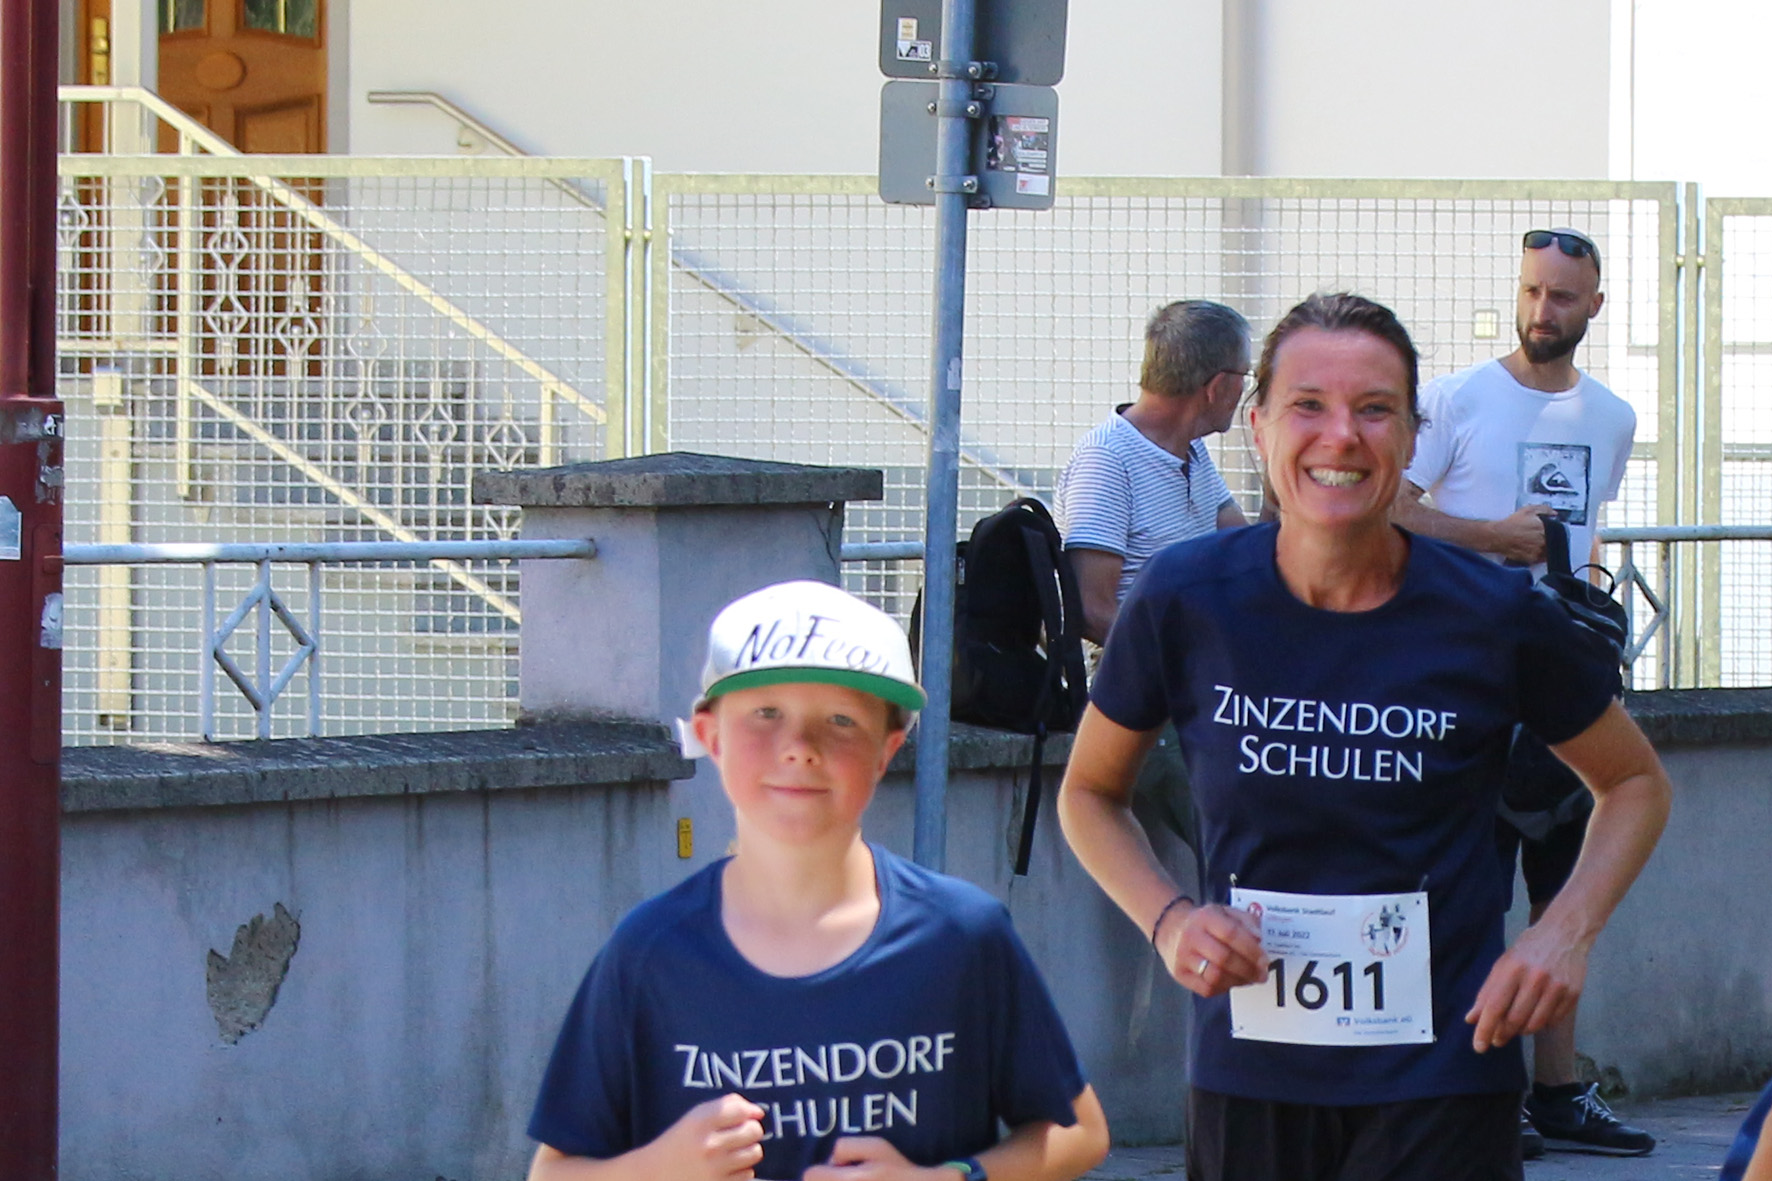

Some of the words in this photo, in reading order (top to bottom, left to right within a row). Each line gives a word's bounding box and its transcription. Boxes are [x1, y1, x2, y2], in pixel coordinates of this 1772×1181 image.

[1213, 685, 1457, 741] ZINZENDORF
[1239, 735, 1423, 782] SCHULEN
[1268, 957, 1385, 1012] 1611
[674, 1032, 956, 1089] ZINZENDORF
